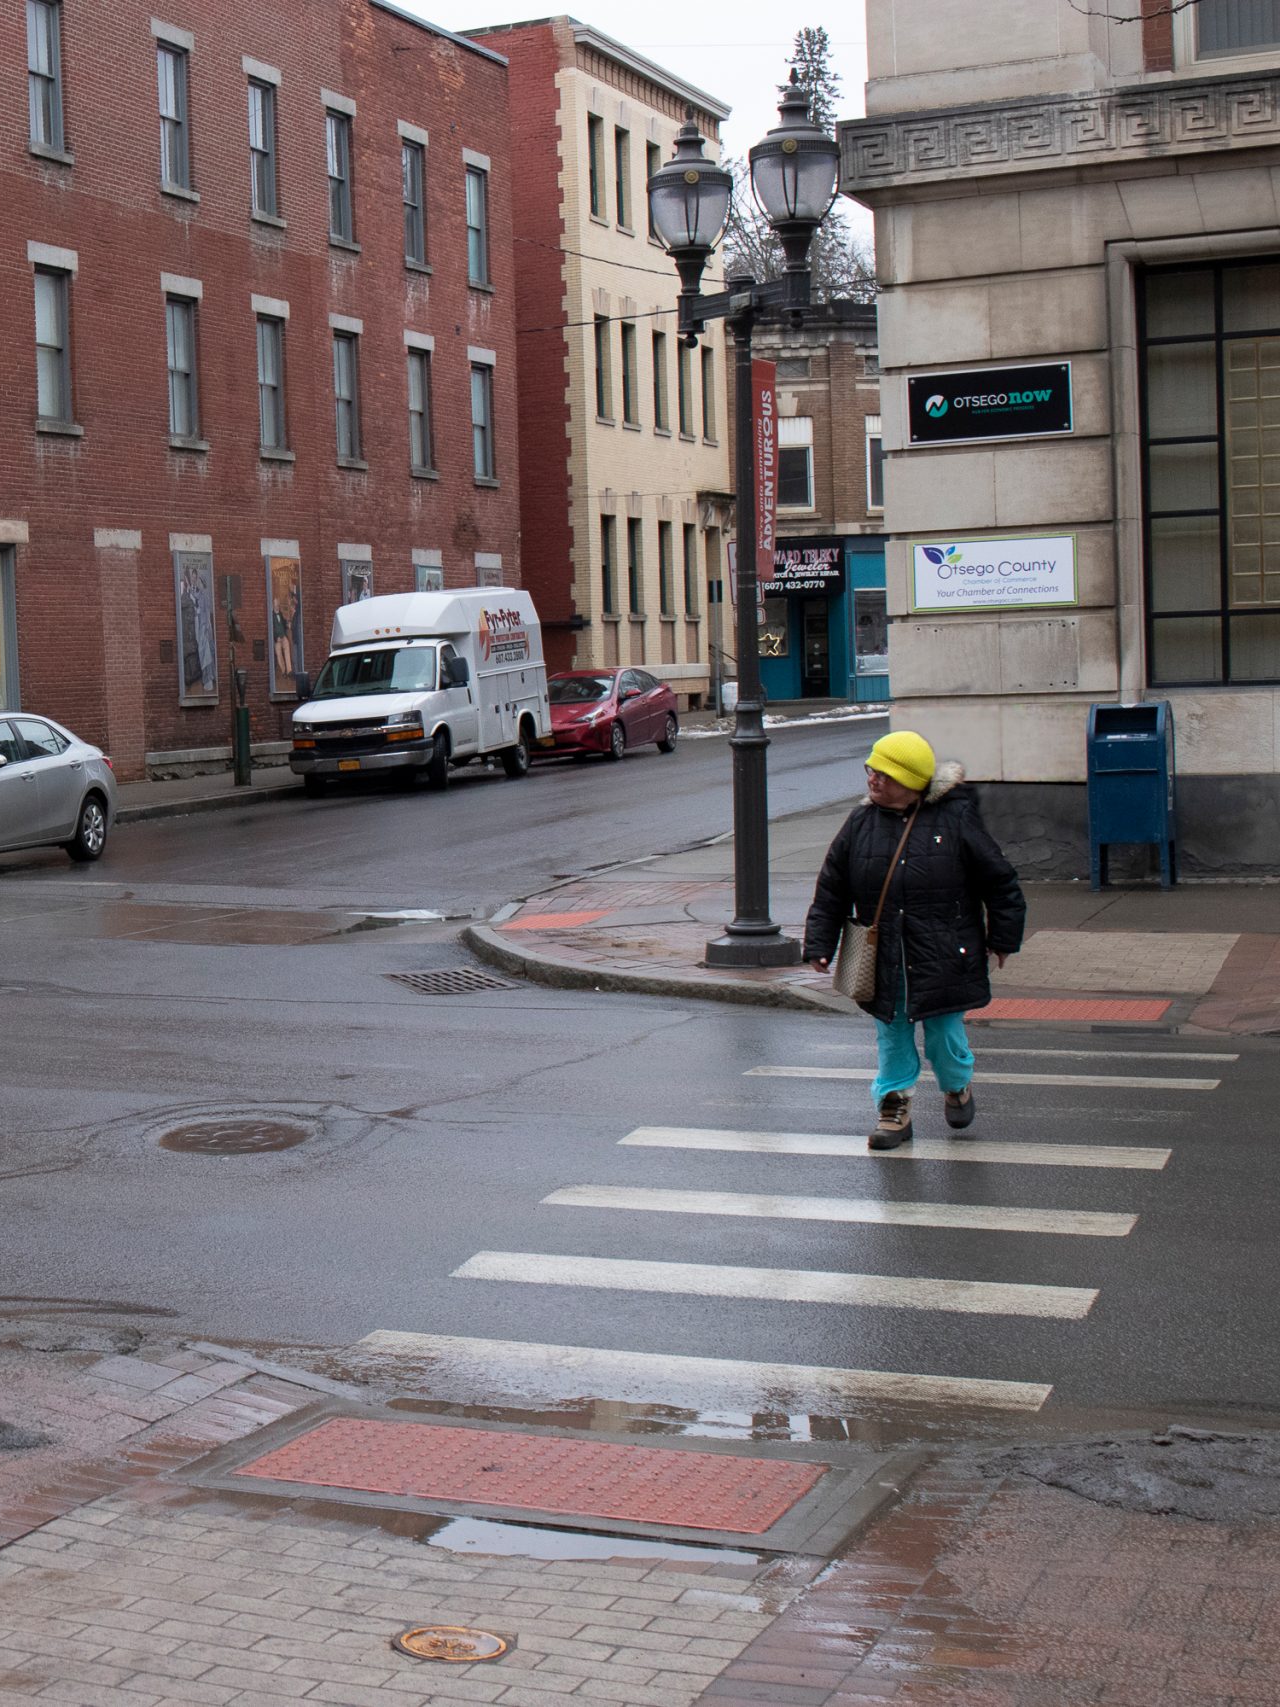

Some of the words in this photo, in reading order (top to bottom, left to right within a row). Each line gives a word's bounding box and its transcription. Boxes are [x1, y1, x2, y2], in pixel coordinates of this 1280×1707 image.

[762, 390, 773, 551] ADVENTUROUS
[785, 560, 830, 577] Jeweler
[937, 563, 994, 580] Otsego
[998, 559, 1056, 577] County
[785, 580, 825, 590] 432-0770
[962, 578, 992, 586] Chamber
[936, 588, 955, 598] Your
[957, 586, 995, 597] Chamber
[996, 585, 1006, 595] of
[1006, 584, 1059, 595] Connections
[484, 608, 521, 634] Fyr-Fyter
